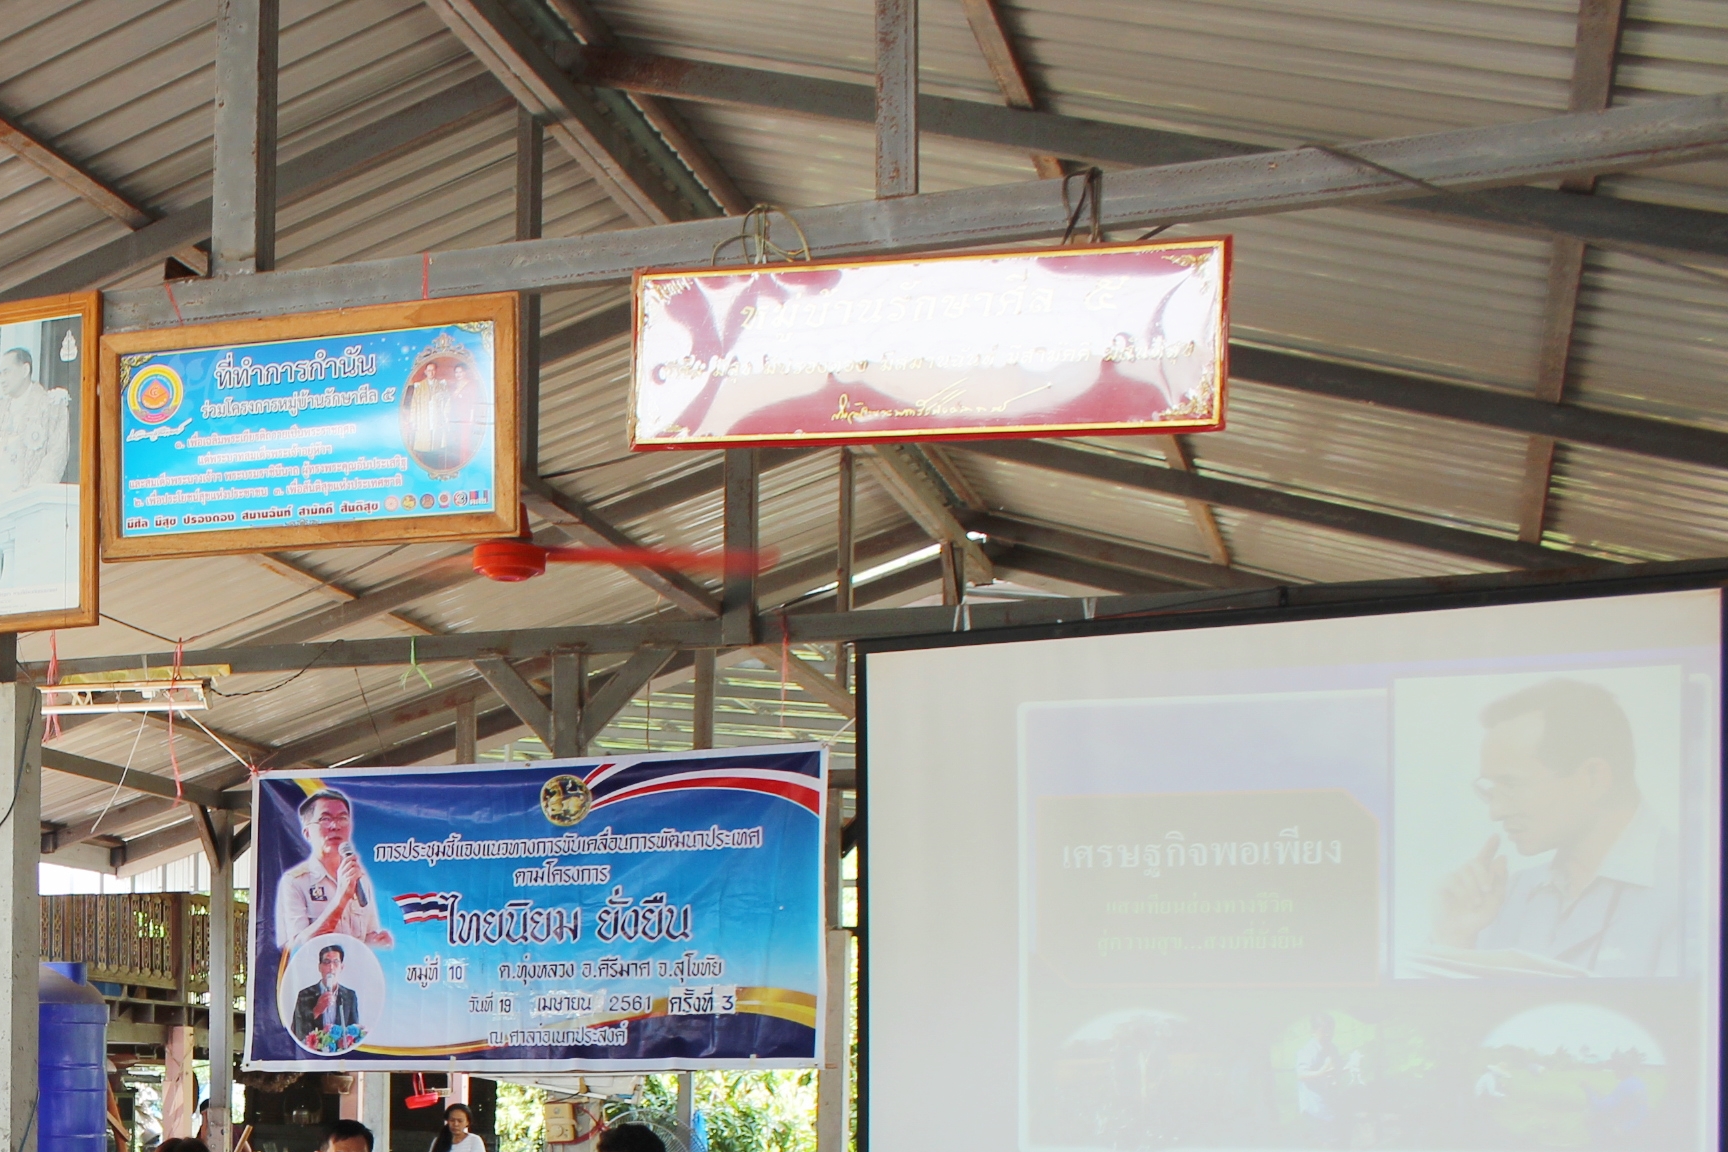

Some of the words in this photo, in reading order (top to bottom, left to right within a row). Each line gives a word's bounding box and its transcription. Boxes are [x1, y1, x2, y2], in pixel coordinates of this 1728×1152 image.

[740, 269, 1055, 342] หมู่บ้านรักษาศีล
[1084, 276, 1131, 311] ๕
[214, 346, 377, 390] ที่ทำการกำนัน
[201, 384, 378, 418] ร่วมโครงการหมู่บ้านรักษาศีล
[382, 387, 397, 402] ๕
[183, 512, 235, 525] ปรองดอง
[242, 505, 292, 520] สมานฉันท์
[298, 502, 333, 516] สามัคคี
[340, 500, 379, 514] สันติสุข
[374, 825, 763, 866] การประชุมชี้แจงแนวทางการขับเคลื่อนการพัฒนาประเทศ
[1062, 825, 1343, 878] เศรษฐกิจพอเพียง
[513, 859, 611, 887] ตามโครงการ
[439, 891, 580, 946] ไทยนิยม
[595, 885, 693, 943] ยั่งยืน
[405, 957, 442, 990] หมู่ที่
[448, 964, 465, 981] 10
[498, 956, 576, 986] ต.ทุ่งหลวง
[581, 956, 652, 980] อ.คีรีมาศ
[657, 954, 724, 986] จ.สุโขทัย
[468, 990, 495, 1013] วันที่
[498, 997, 513, 1013] 19
[537, 995, 593, 1012] เมษายน
[608, 994, 653, 1012] 2561
[668, 988, 717, 1014] ครั้งที่
[722, 995, 734, 1011] 3
[509, 1021, 629, 1046] ศาลาอเนกประสงค์
